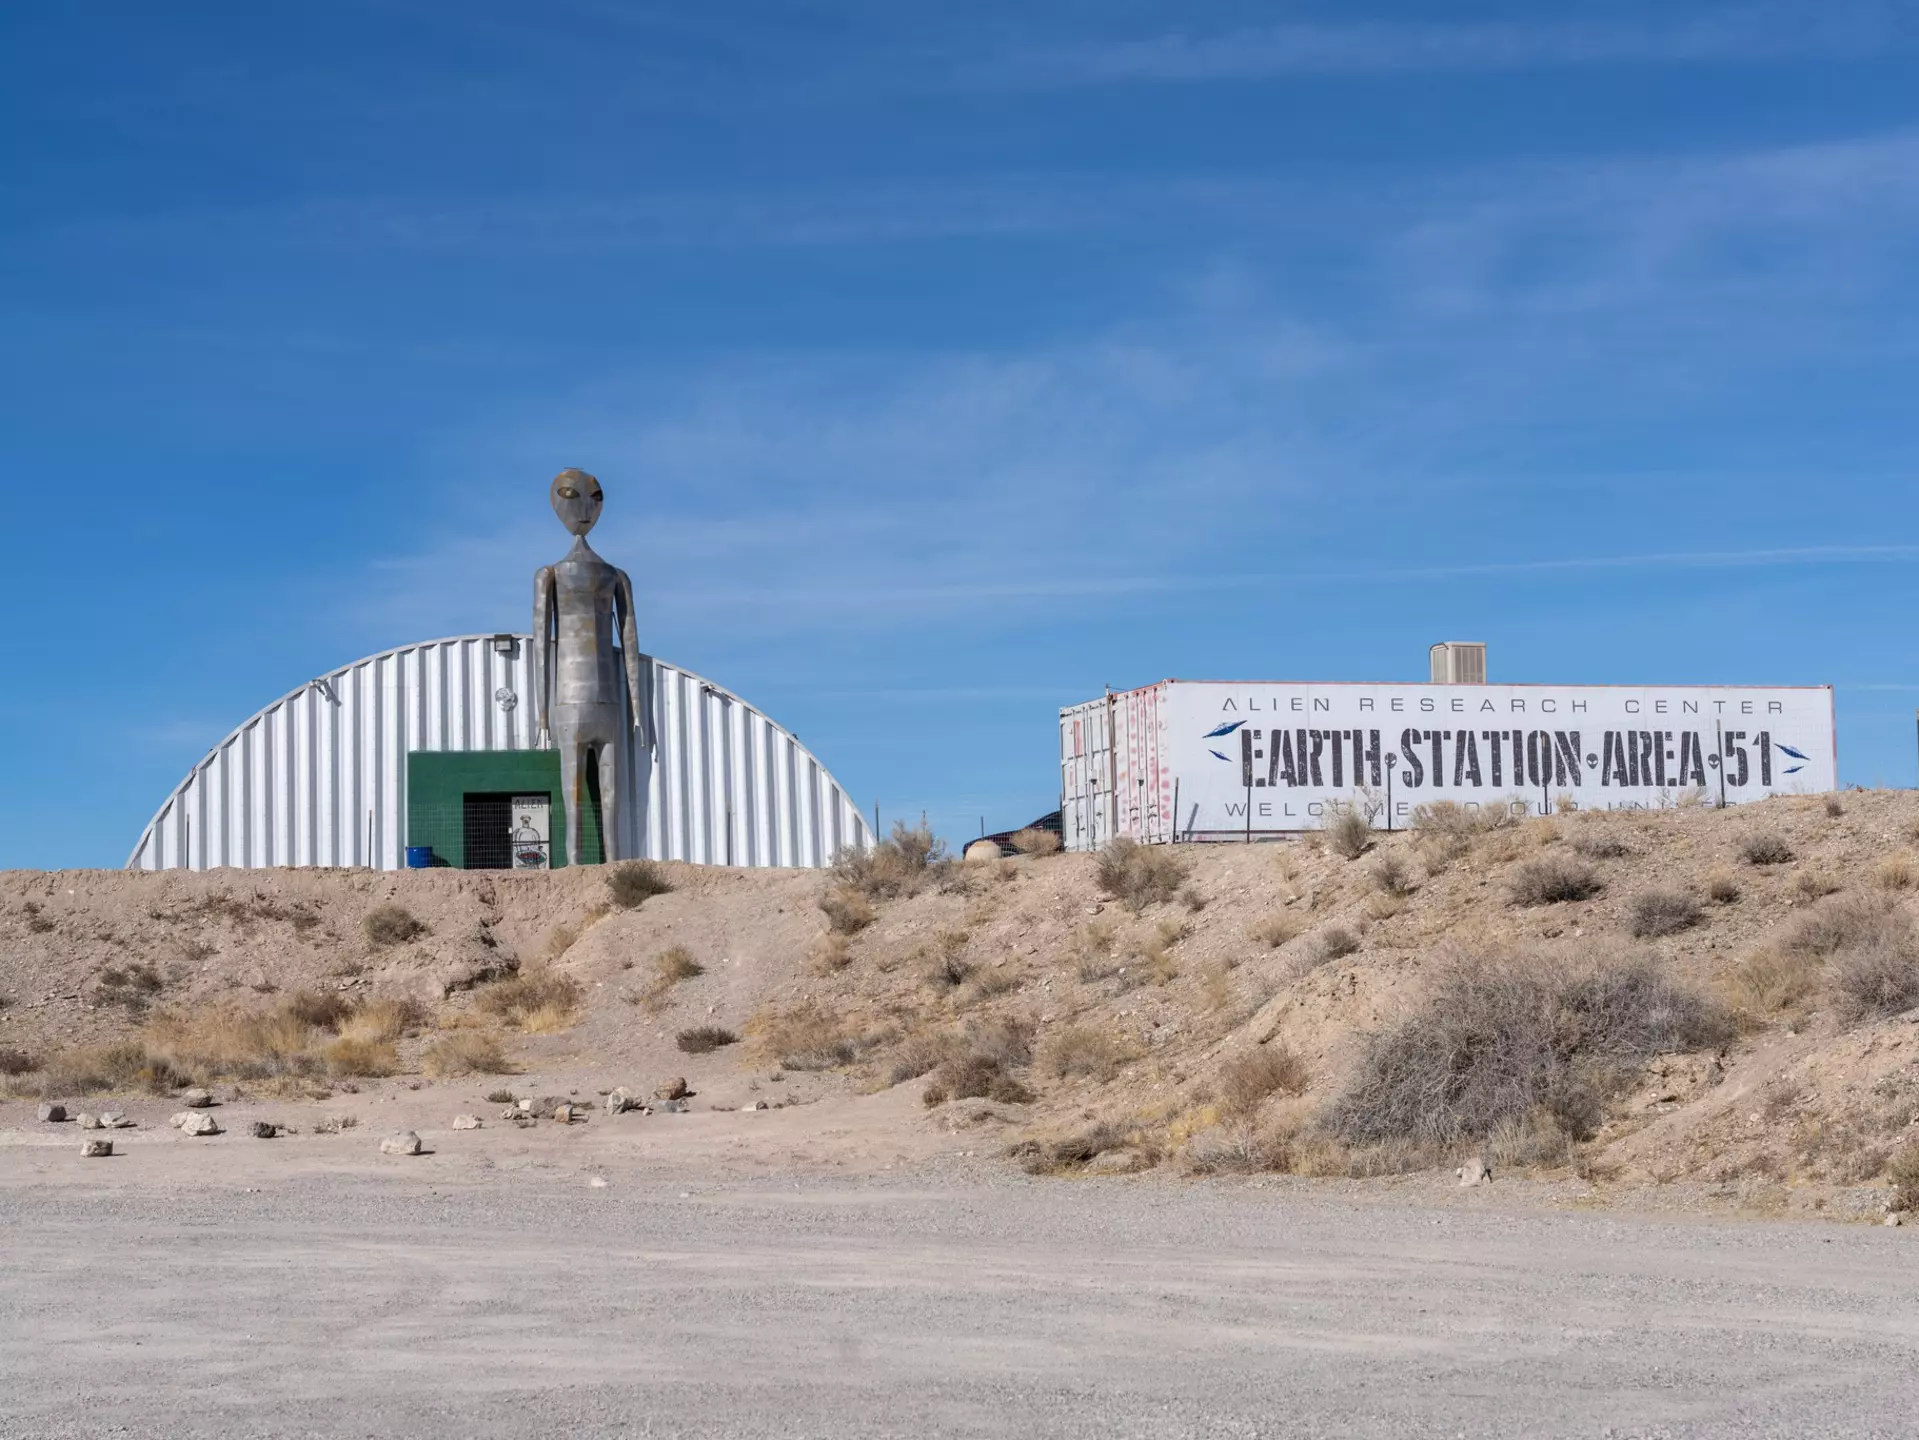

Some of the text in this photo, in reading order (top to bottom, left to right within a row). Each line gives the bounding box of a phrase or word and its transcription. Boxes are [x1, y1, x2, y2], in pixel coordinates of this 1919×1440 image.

[1222, 697, 1783, 714] ALIEN RESEARCH CENTER
[1240, 728, 1773, 788] EARTH STATION AREA 51
